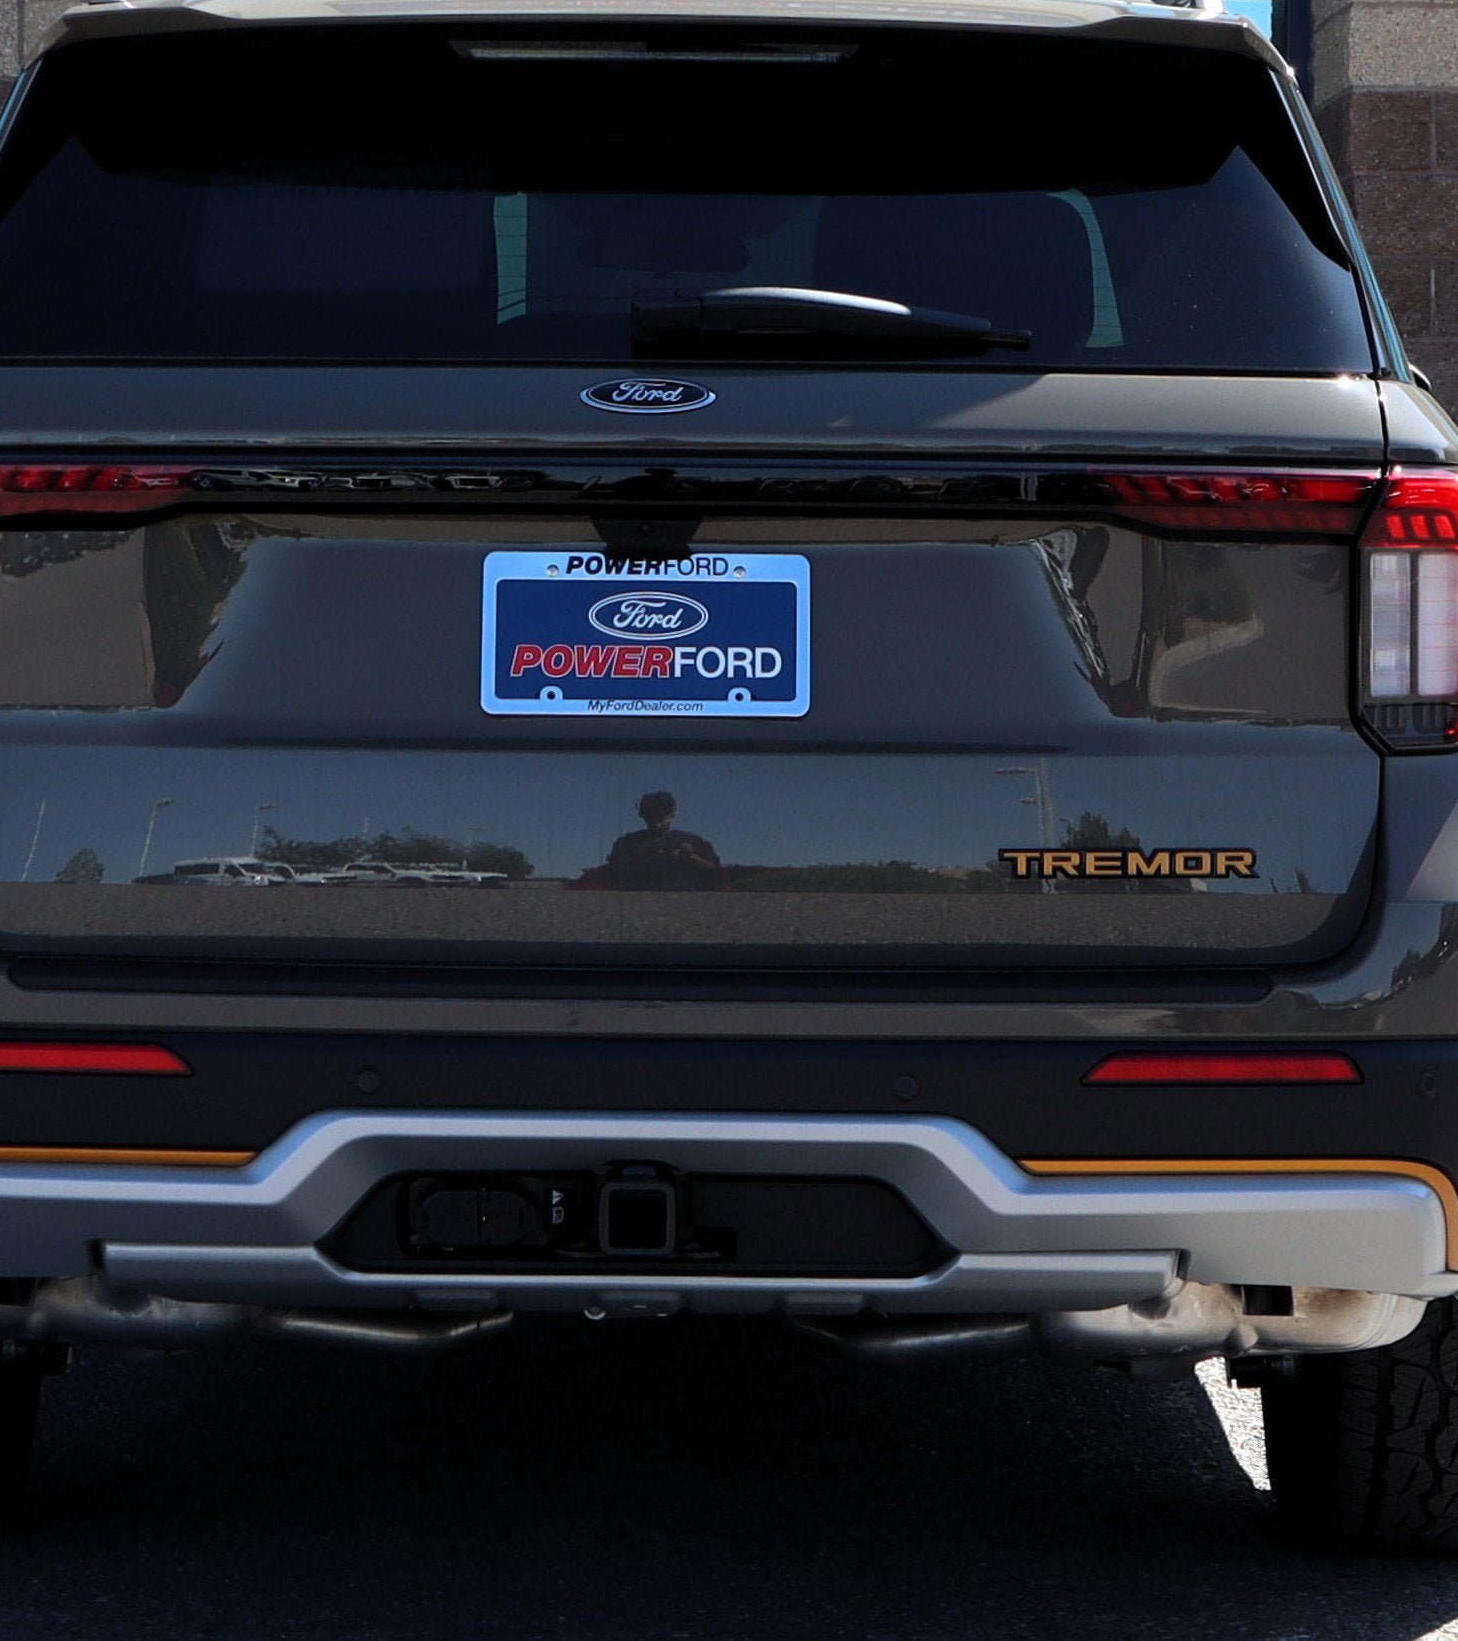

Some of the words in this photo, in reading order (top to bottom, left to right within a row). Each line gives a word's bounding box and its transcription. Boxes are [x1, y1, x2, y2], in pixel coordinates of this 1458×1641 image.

[611, 381, 683, 403] Ford
[565, 555, 729, 577] POWERFORD
[612, 598, 683, 630] Ford
[510, 644, 783, 679] POWERFORD
[587, 700, 704, 713] MyFordDealer.com
[998, 848, 1260, 879] TREMOR
